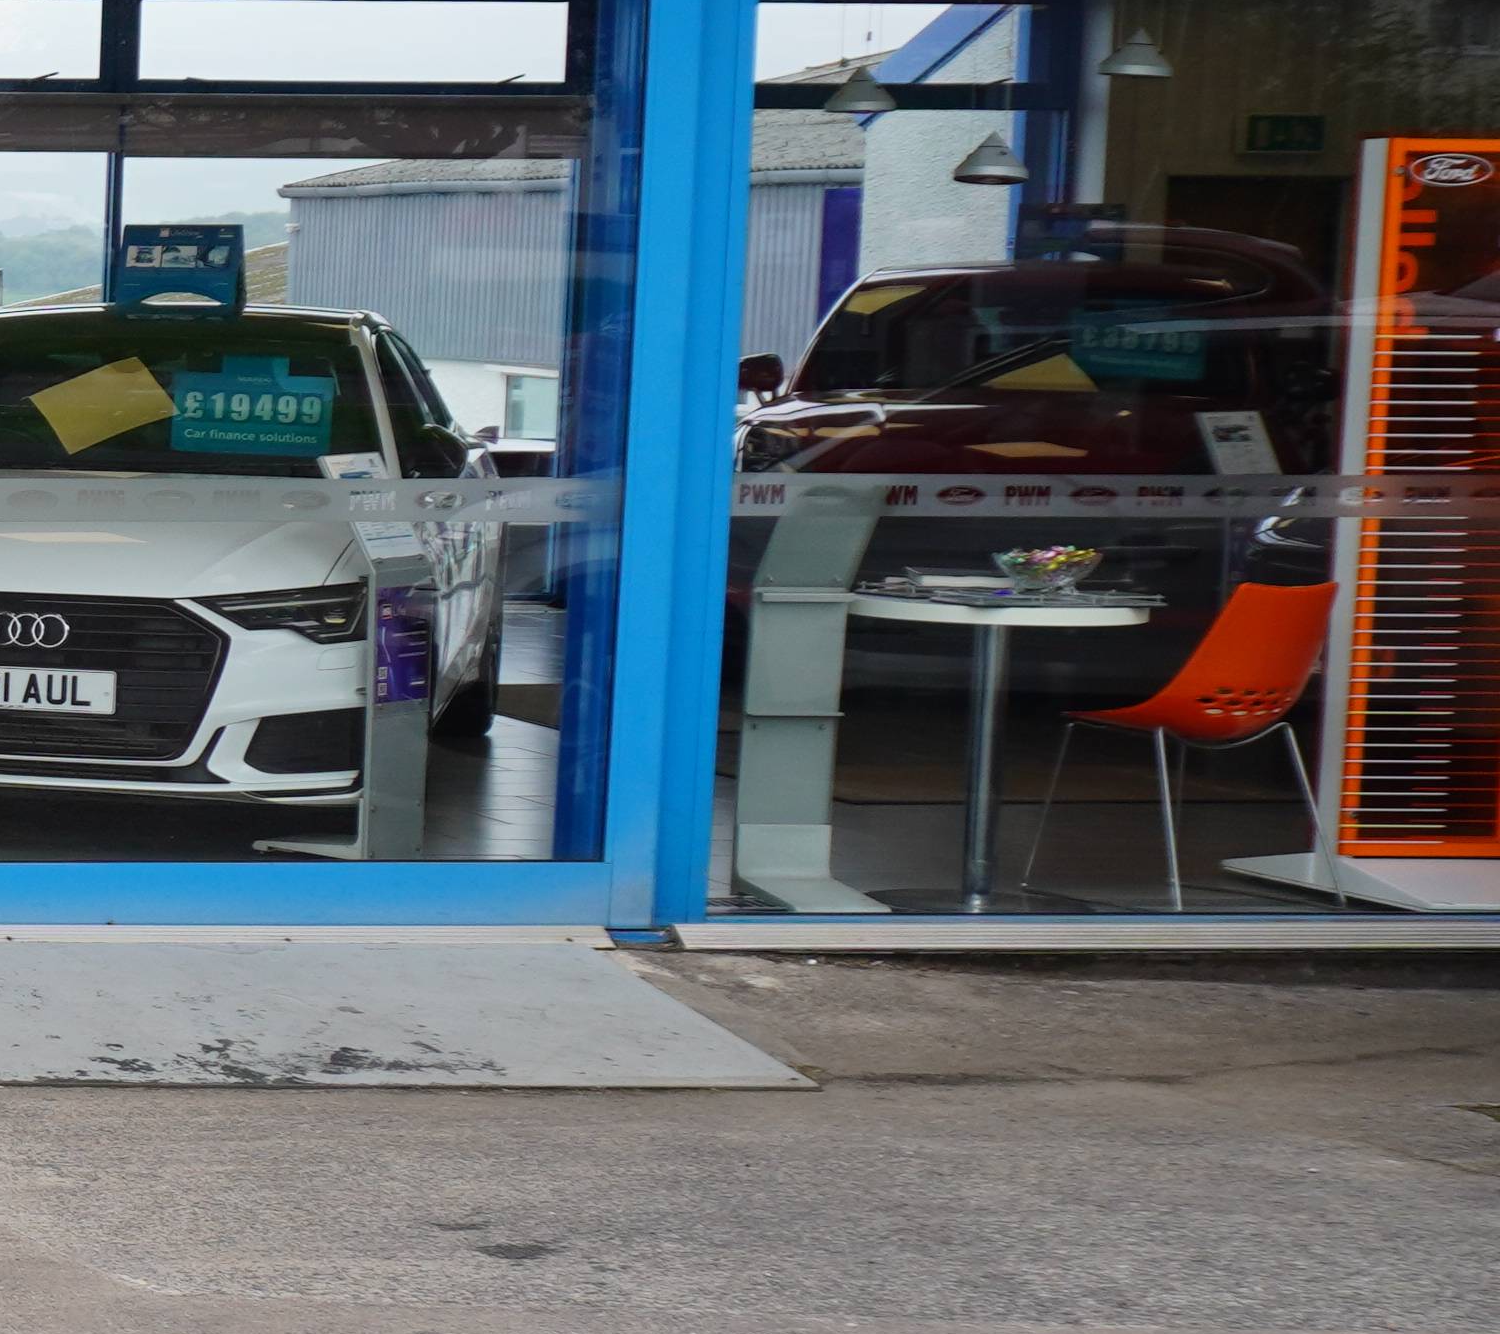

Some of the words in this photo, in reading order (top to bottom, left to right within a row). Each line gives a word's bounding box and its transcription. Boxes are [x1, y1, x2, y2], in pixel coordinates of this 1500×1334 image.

[1423, 156, 1481, 182] Ford
[184, 391, 322, 424] £19499
[184, 428, 205, 438] Car
[209, 429, 256, 440] finance
[260, 430, 317, 444] solutions
[739, 484, 785, 504] PWM
[23, 673, 92, 706] AUL
